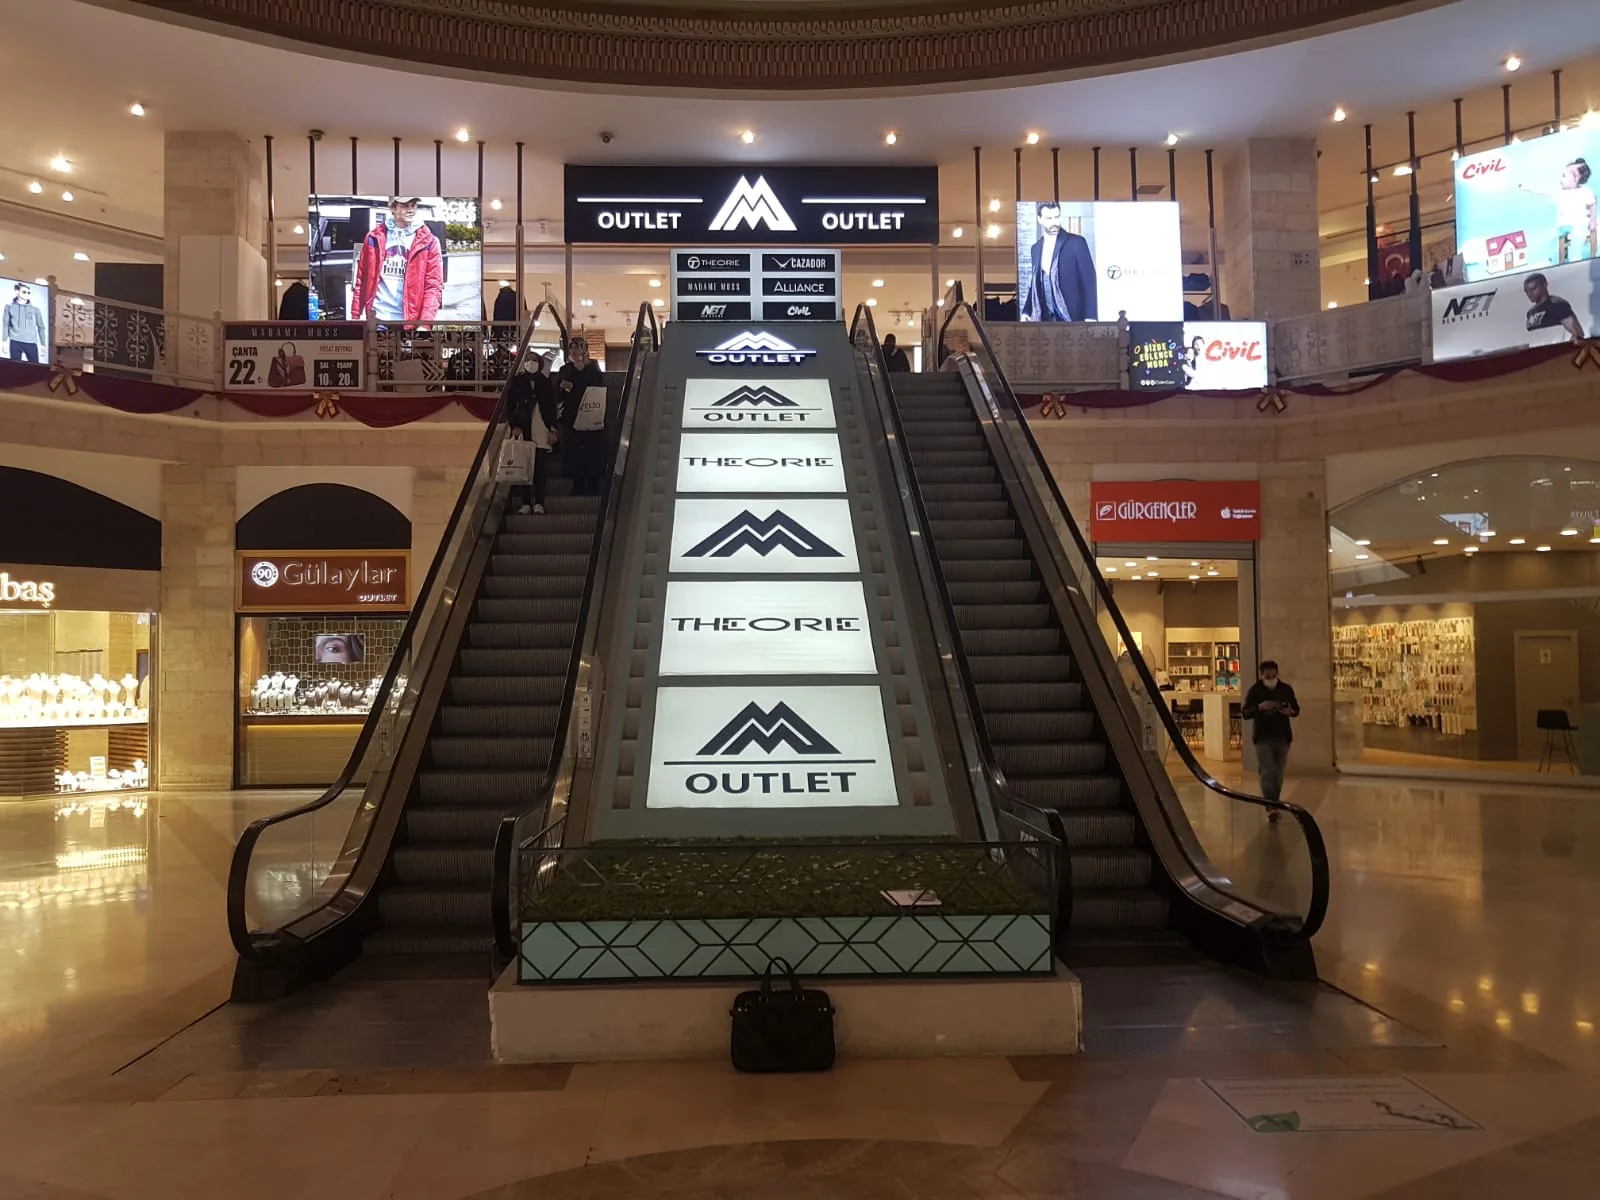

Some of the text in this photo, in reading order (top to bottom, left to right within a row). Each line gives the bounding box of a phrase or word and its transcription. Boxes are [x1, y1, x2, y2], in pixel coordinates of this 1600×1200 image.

[598, 211, 682, 231] OUTLET
[821, 212, 905, 231] OUTLET
[700, 259, 741, 267] THEORIE
[790, 258, 826, 269] CAZADOR
[687, 282, 741, 292] MADAME MOSS
[773, 281, 825, 293] ALLIANCE
[251, 327, 339, 337] MADAME MOSS
[232, 346, 258, 358] ÇANTA
[707, 353, 806, 364] OUTLET
[1146, 359, 1169, 369] MODA
[229, 359, 256, 385] 22
[318, 372, 330, 386] 10
[338, 372, 351, 386] 20
[703, 412, 811, 423] OUTLET
[683, 456, 834, 469] THEORIE
[1118, 499, 1197, 524] GÜRGENÇLER
[257, 560, 398, 592] 90 Gülaylar
[357, 593, 398, 602] OUTLET
[671, 617, 861, 632] THEORIE
[684, 771, 857, 796] OUTLET
